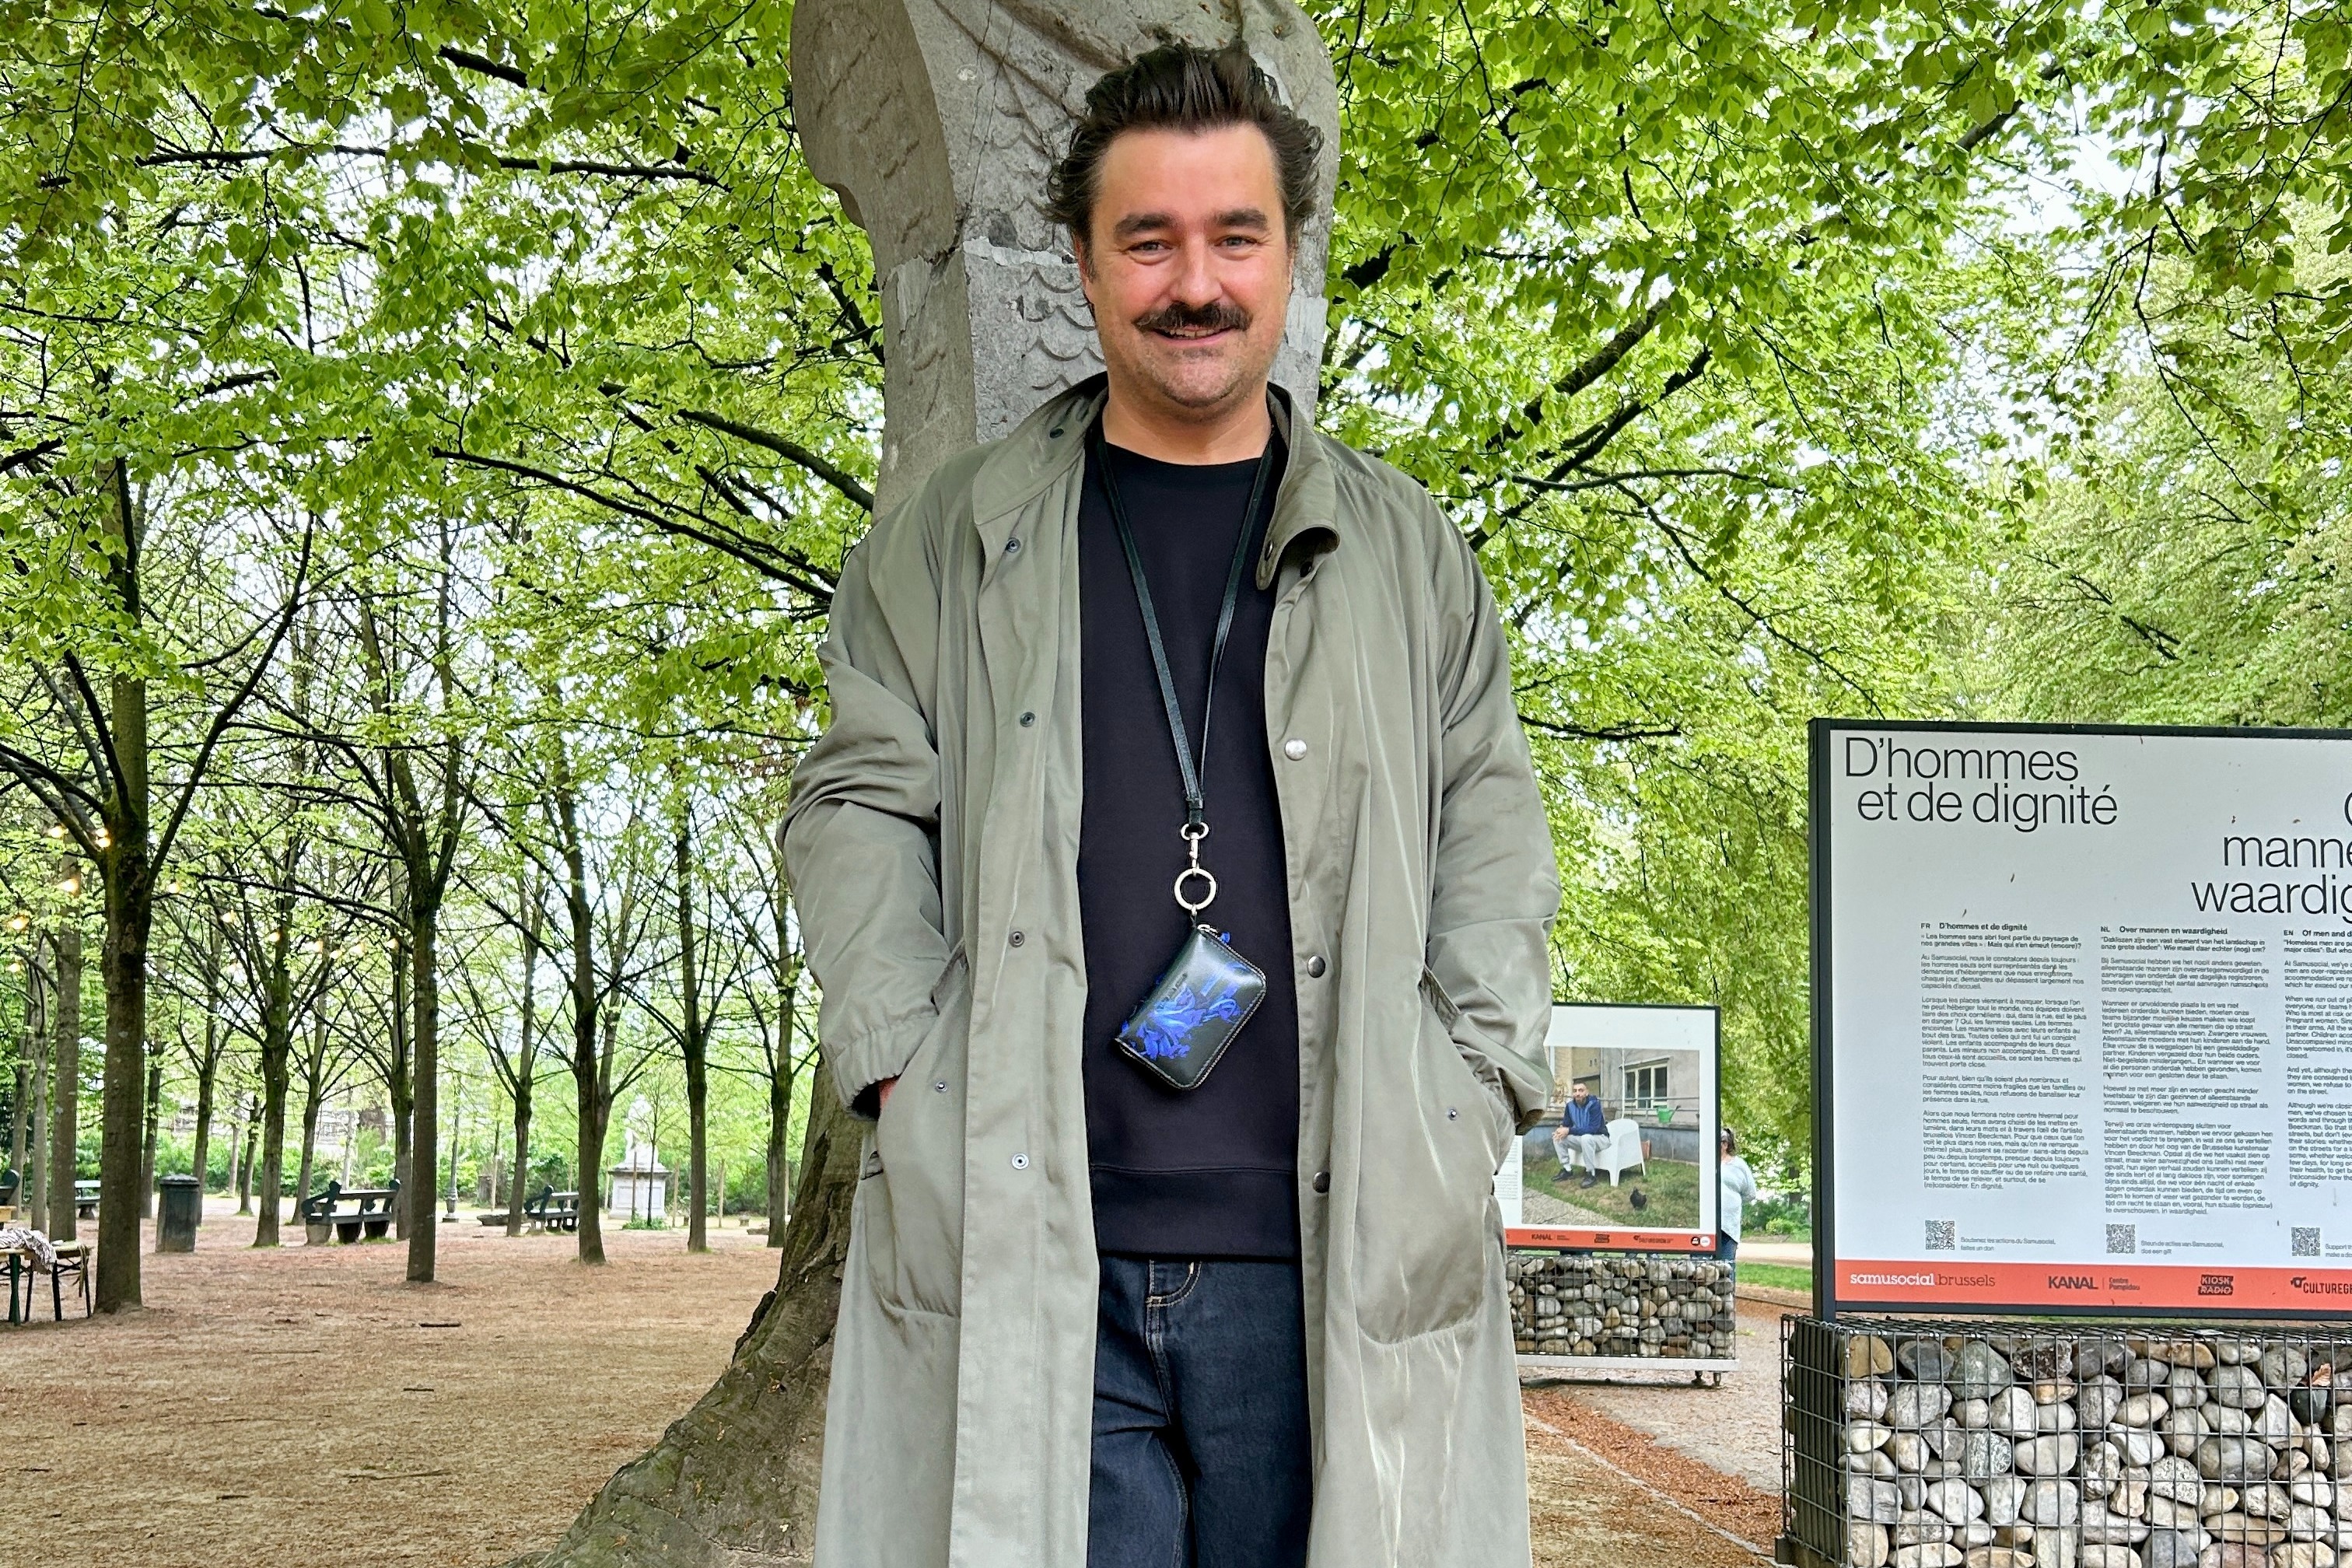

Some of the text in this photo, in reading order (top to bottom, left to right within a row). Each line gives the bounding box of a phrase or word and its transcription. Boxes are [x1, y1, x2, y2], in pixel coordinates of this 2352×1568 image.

[1846, 737, 2078, 781] D'hommes
[1858, 782, 2117, 832] et de dignité
[2224, 837, 2352, 868] mann
[2049, 1276, 2098, 1290] KANAL
[2200, 1286, 2231, 1294] RADIO
[2202, 1276, 2231, 1285] KIOSK
